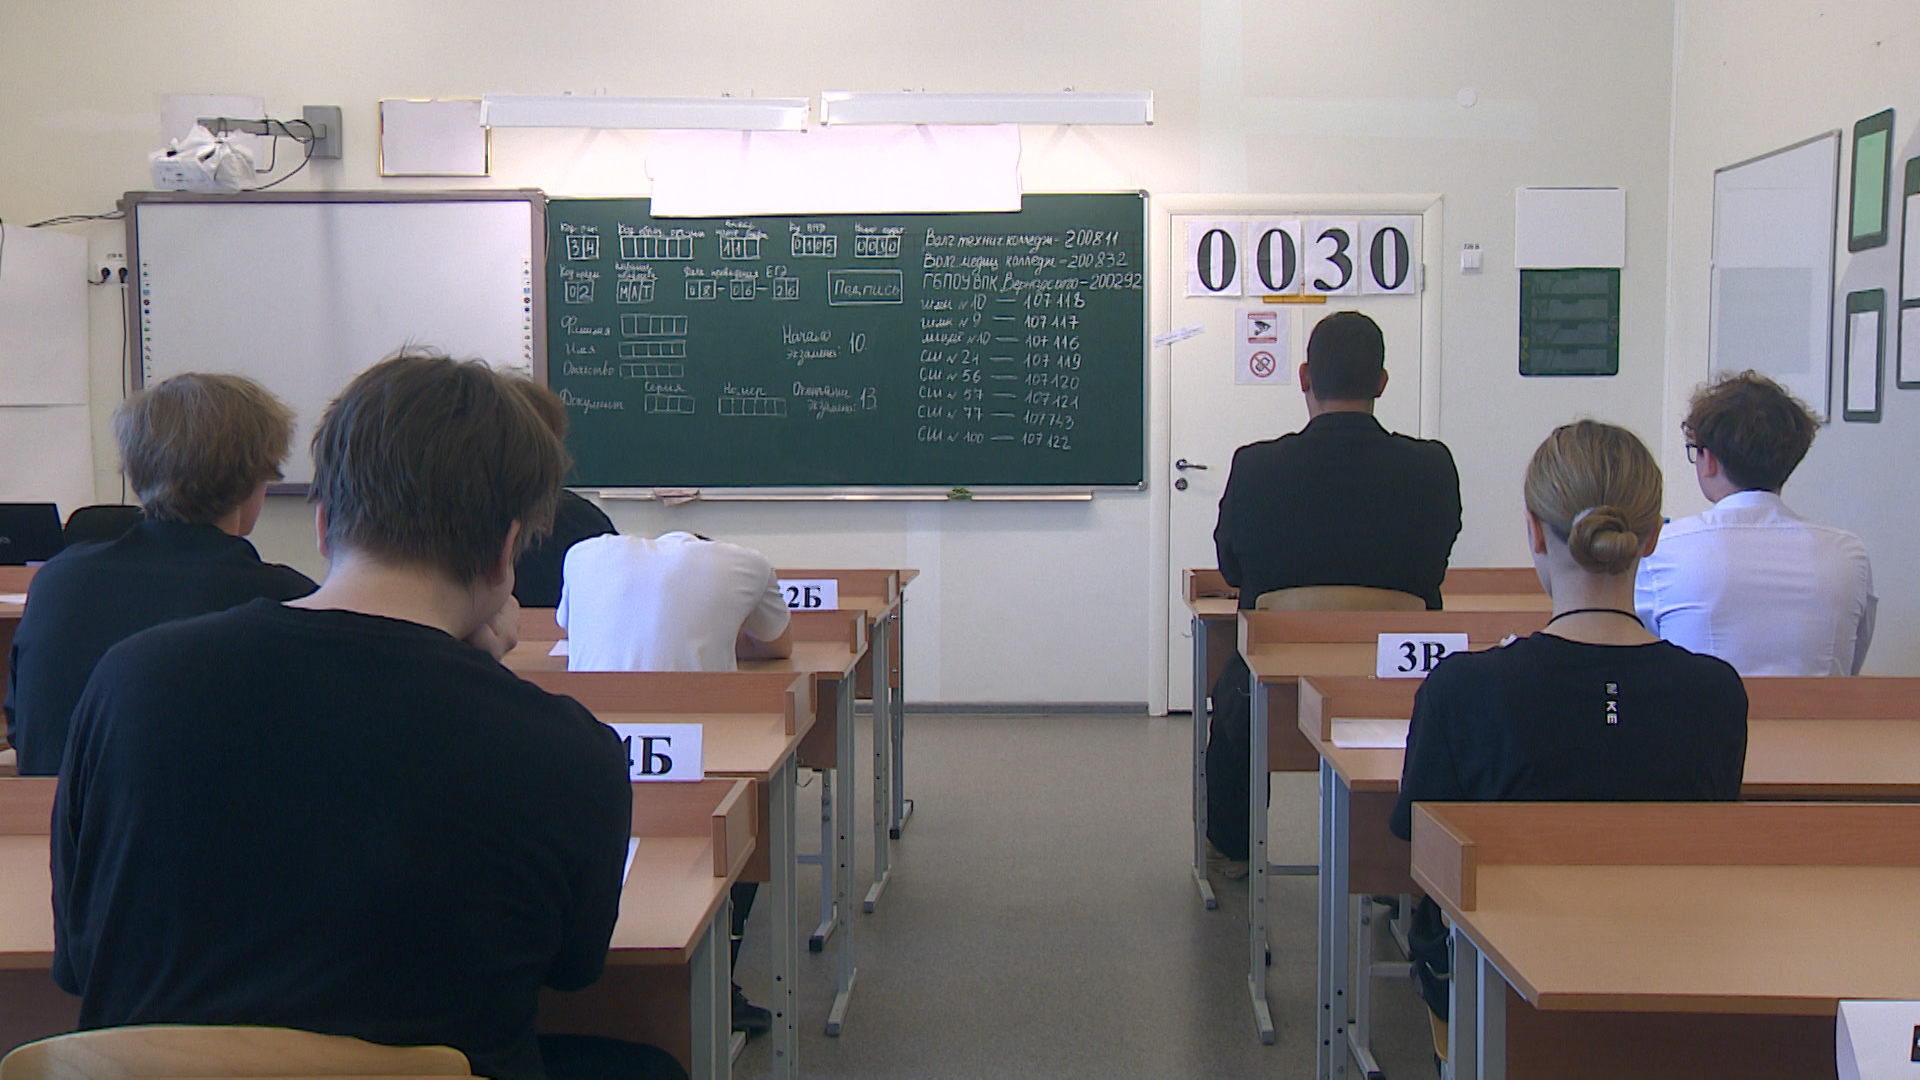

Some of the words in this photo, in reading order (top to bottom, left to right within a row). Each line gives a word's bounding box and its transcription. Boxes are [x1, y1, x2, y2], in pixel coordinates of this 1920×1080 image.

[1064, 228, 1120, 249] 200811
[766, 265, 788, 278] ЕГЭ
[834, 279, 900, 297] Подпись
[923, 273, 971, 290] ГБПОУ
[973, 274, 998, 292] ВПК
[1088, 272, 1143, 291] 200292
[620, 285, 651, 299] МАТ
[970, 293, 987, 311] 10
[561, 315, 611, 336] Фамилия
[973, 311, 982, 328] 9
[782, 324, 832, 345] Начало
[565, 342, 596, 355] Имя
[920, 350, 943, 363] СШ
[563, 360, 615, 376] Отчество
[919, 367, 942, 382] СШ
[961, 369, 982, 384] 56
[644, 381, 687, 395] Серия
[723, 381, 767, 398] Номер
[792, 381, 851, 399] Окончание
[918, 385, 942, 399] СШ
[963, 388, 984, 402] 57
[560, 388, 625, 415] Документ
[917, 405, 942, 419] СШ
[963, 407, 983, 422] 77
[917, 425, 943, 442] СШ
[963, 432, 984, 444] 100
[786, 585, 822, 608] 2Б
